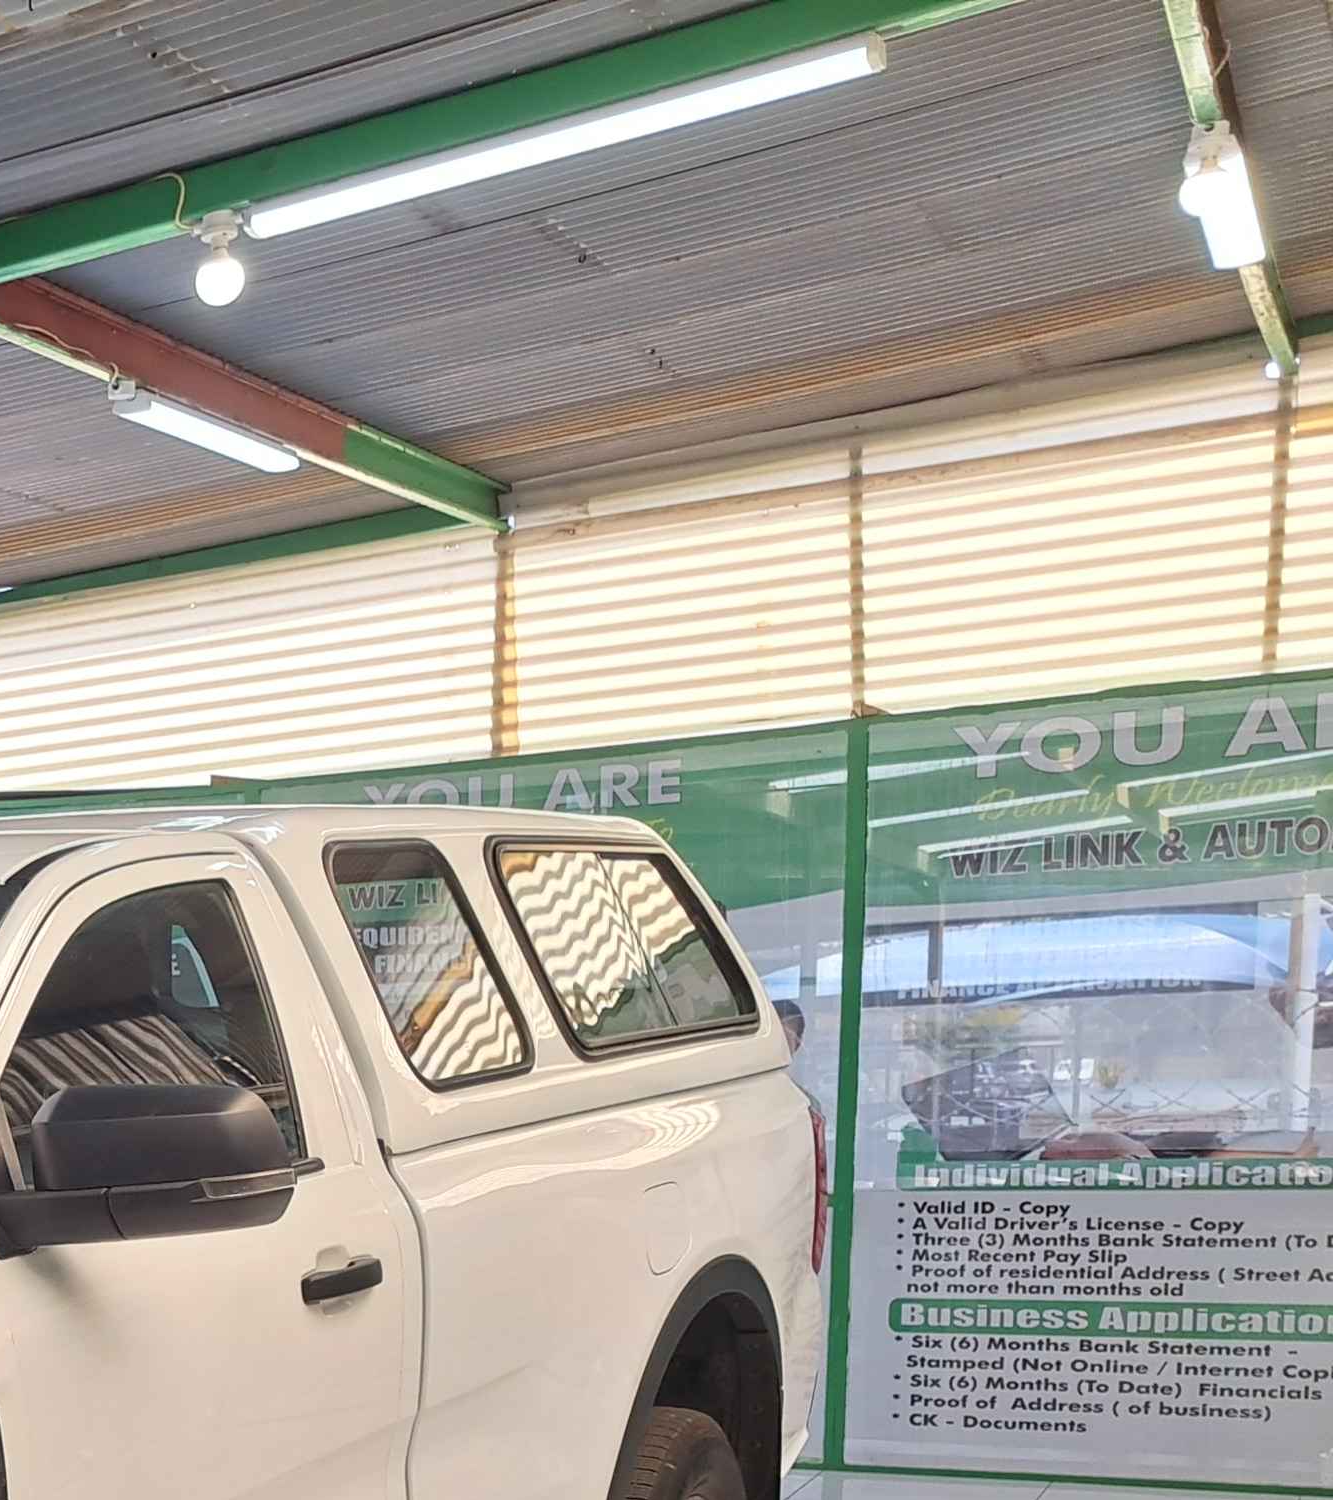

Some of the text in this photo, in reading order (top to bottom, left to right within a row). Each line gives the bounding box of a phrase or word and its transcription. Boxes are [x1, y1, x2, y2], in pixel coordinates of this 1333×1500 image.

[953, 692, 1333, 779] YOU A
[542, 758, 683, 812] ARE
[949, 814, 1333, 879] WIZ LINK & AUTO
[347, 883, 407, 912] WIZ
[914, 1163, 1110, 1187] Individual
[913, 1201, 965, 1214] Valid
[973, 1201, 996, 1214] ID
[1019, 1201, 1071, 1217] Copy
[912, 1217, 927, 1230] A
[935, 1217, 986, 1231] Valid
[994, 1217, 1078, 1231] Driver's
[1086, 1217, 1165, 1231] License
[1190, 1217, 1245, 1234] Copy
[912, 1233, 971, 1246] Three
[977, 1233, 1005, 1249] (3)
[1012, 1234, 1090, 1247] Months
[1097, 1234, 1154, 1248] Bank
[1162, 1234, 1277, 1249] Statement
[1285, 1234, 1318, 1251] (To
[911, 1249, 1128, 1267] Most Recent Pay Slip
[911, 1265, 966, 1278] Proof
[972, 1265, 993, 1279] of
[1000, 1265, 1113, 1280] residential
[1121, 1266, 1210, 1281] Address
[1233, 1267, 1300, 1282] Street
[906, 1281, 1184, 1297] not more than months old
[900, 1303, 1333, 1334] Business Applicatio
[911, 1335, 943, 1349] Six
[950, 1336, 979, 1352] (6)
[987, 1337, 1070, 1352] Months
[1079, 1339, 1139, 1354] Bank
[1147, 1341, 1272, 1357] Statement
[906, 1355, 1005, 1372] Stamped
[1013, 1357, 1062, 1374] (Not
[1071, 1359, 1148, 1375] Online
[1176, 1362, 1274, 1378] Internet
[910, 1374, 1323, 1400] Six (6) Months (To Date) Financials
[910, 1394, 969, 1409] Proof
[976, 1396, 998, 1410] of
[1011, 1397, 1104, 1413] Address
[1128, 1401, 1151, 1415] of
[1159, 1402, 1272, 1422] business)
[909, 1413, 939, 1427] CK
[963, 1415, 1088, 1432] Documents
